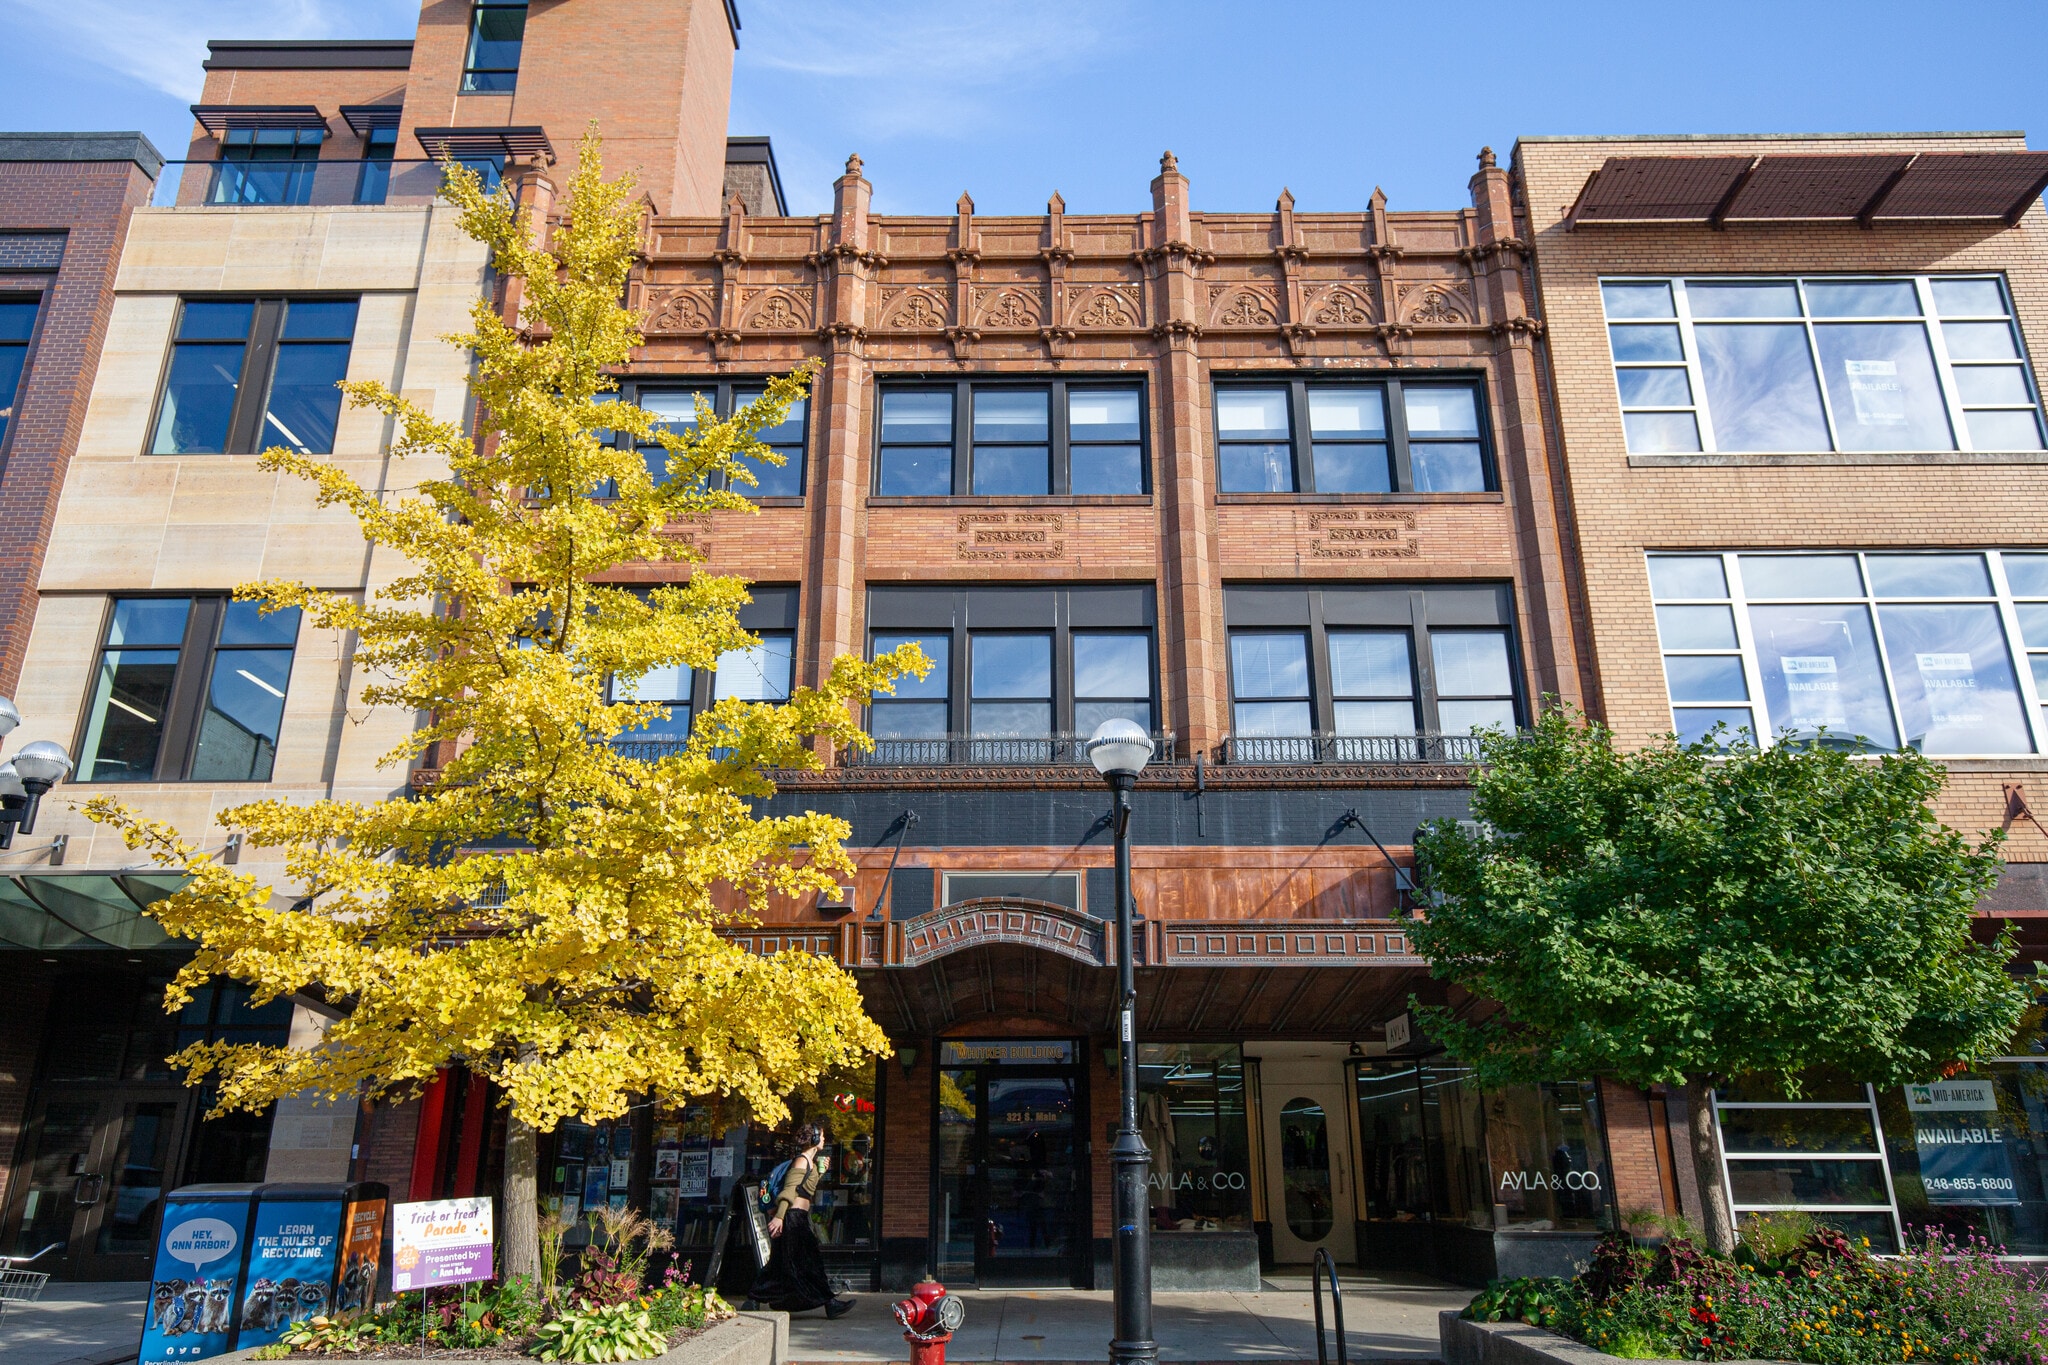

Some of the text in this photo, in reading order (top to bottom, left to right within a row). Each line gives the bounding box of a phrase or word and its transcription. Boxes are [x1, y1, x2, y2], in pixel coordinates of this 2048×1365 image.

[1788, 682, 1839, 691] AVAILABLE
[1924, 678, 1976, 688] AVAILABLE
[956, 1046, 1064, 1059] WHITKER BUILDING
[1932, 1089, 1985, 1102] MID-AMERICA
[1024, 1112, 1033, 1122] S.
[1036, 1112, 1057, 1122] Main
[1917, 1128, 2003, 1144] AVAILABLE
[1148, 1172, 1246, 1190] AYLA & CO.
[1500, 1170, 1602, 1190] AYLA & CO.
[1924, 1177, 2013, 1190] 248-855-6800
[411, 1206, 479, 1224] Trick or treat
[279, 1224, 314, 1235] LEARN
[424, 1220, 467, 1237] Parade
[192, 1230, 213, 1240] HEY,
[257, 1235, 333, 1246] THE RULES OF
[171, 1240, 230, 1250] ANN ARBOR!
[262, 1247, 324, 1258] RECYCLING.
[402, 1249, 414, 1259] 27
[425, 1250, 481, 1264] Presented by:
[399, 1256, 416, 1266] OCT
[439, 1266, 473, 1278] Ann Arbor
